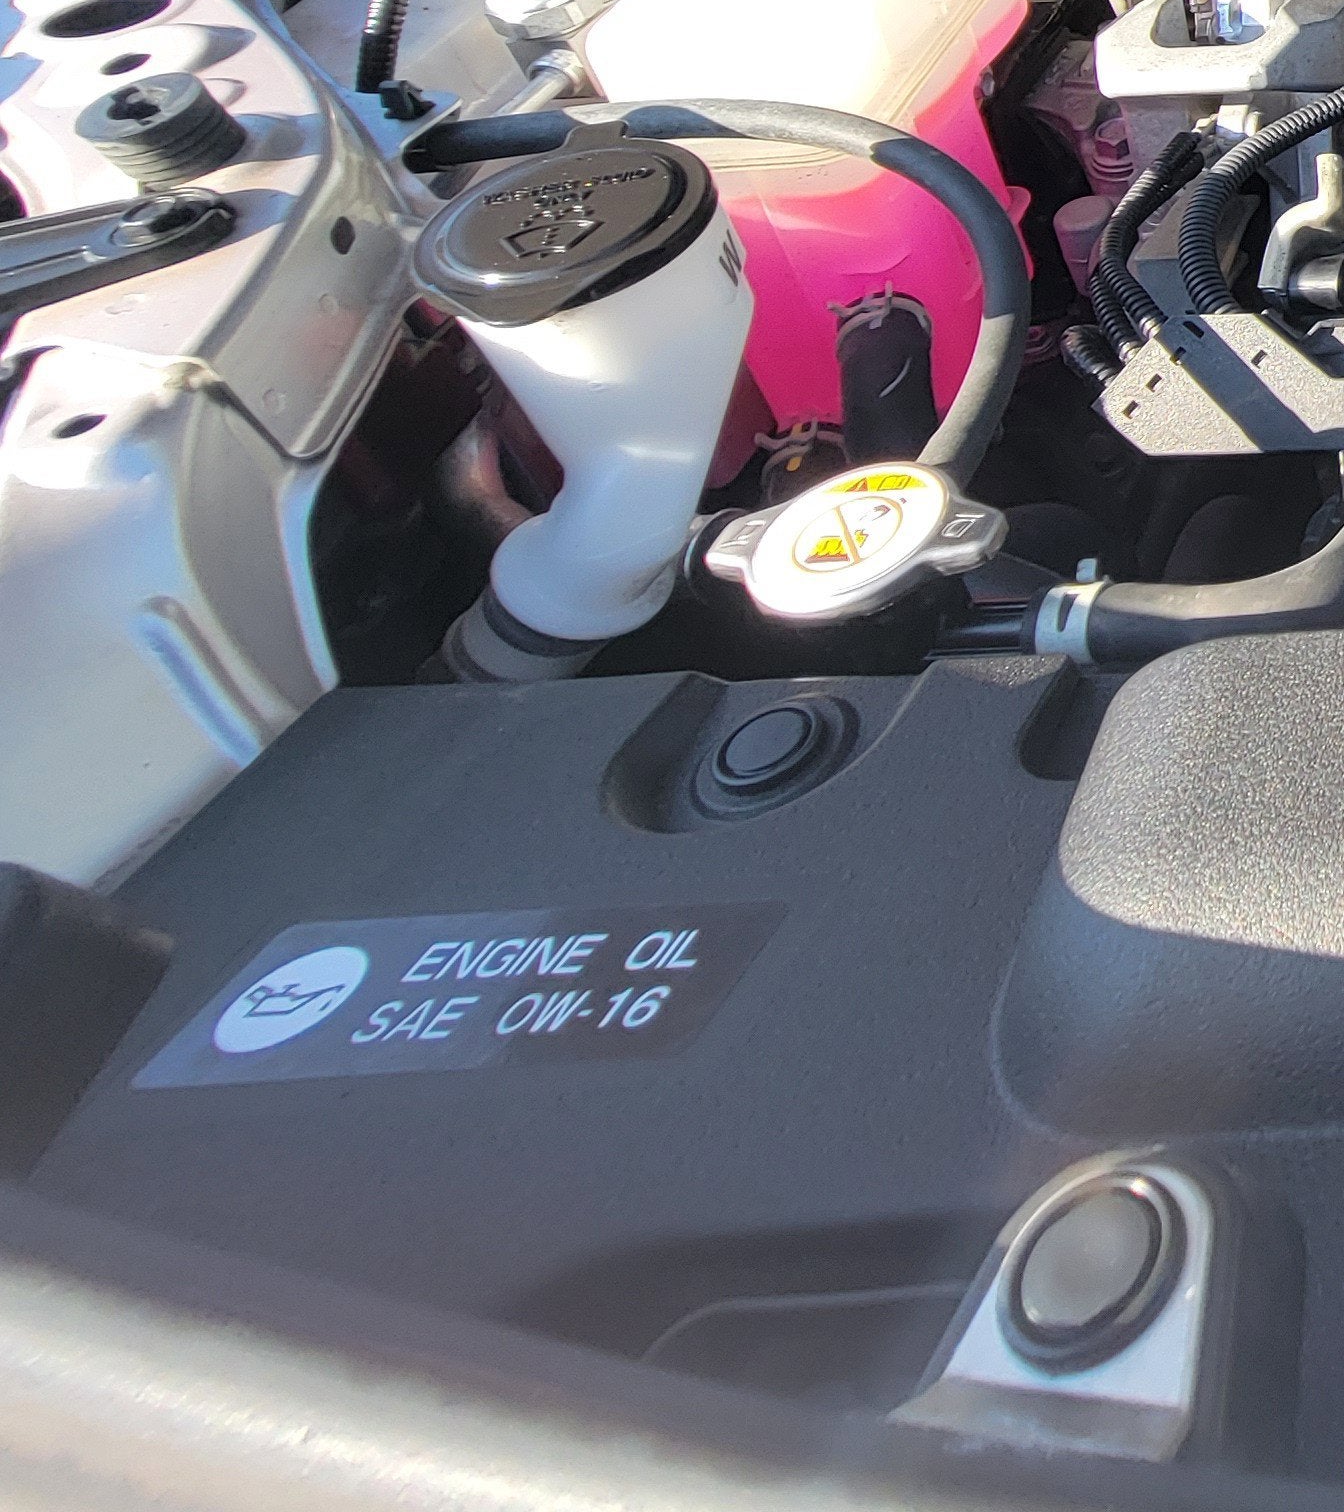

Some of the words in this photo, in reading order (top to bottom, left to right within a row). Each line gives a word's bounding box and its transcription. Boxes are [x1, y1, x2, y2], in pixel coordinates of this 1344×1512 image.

[400, 933, 610, 983] ENGINE
[624, 929, 700, 971] OIL
[350, 996, 481, 1044] SAE
[496, 985, 672, 1036] 0W-16
